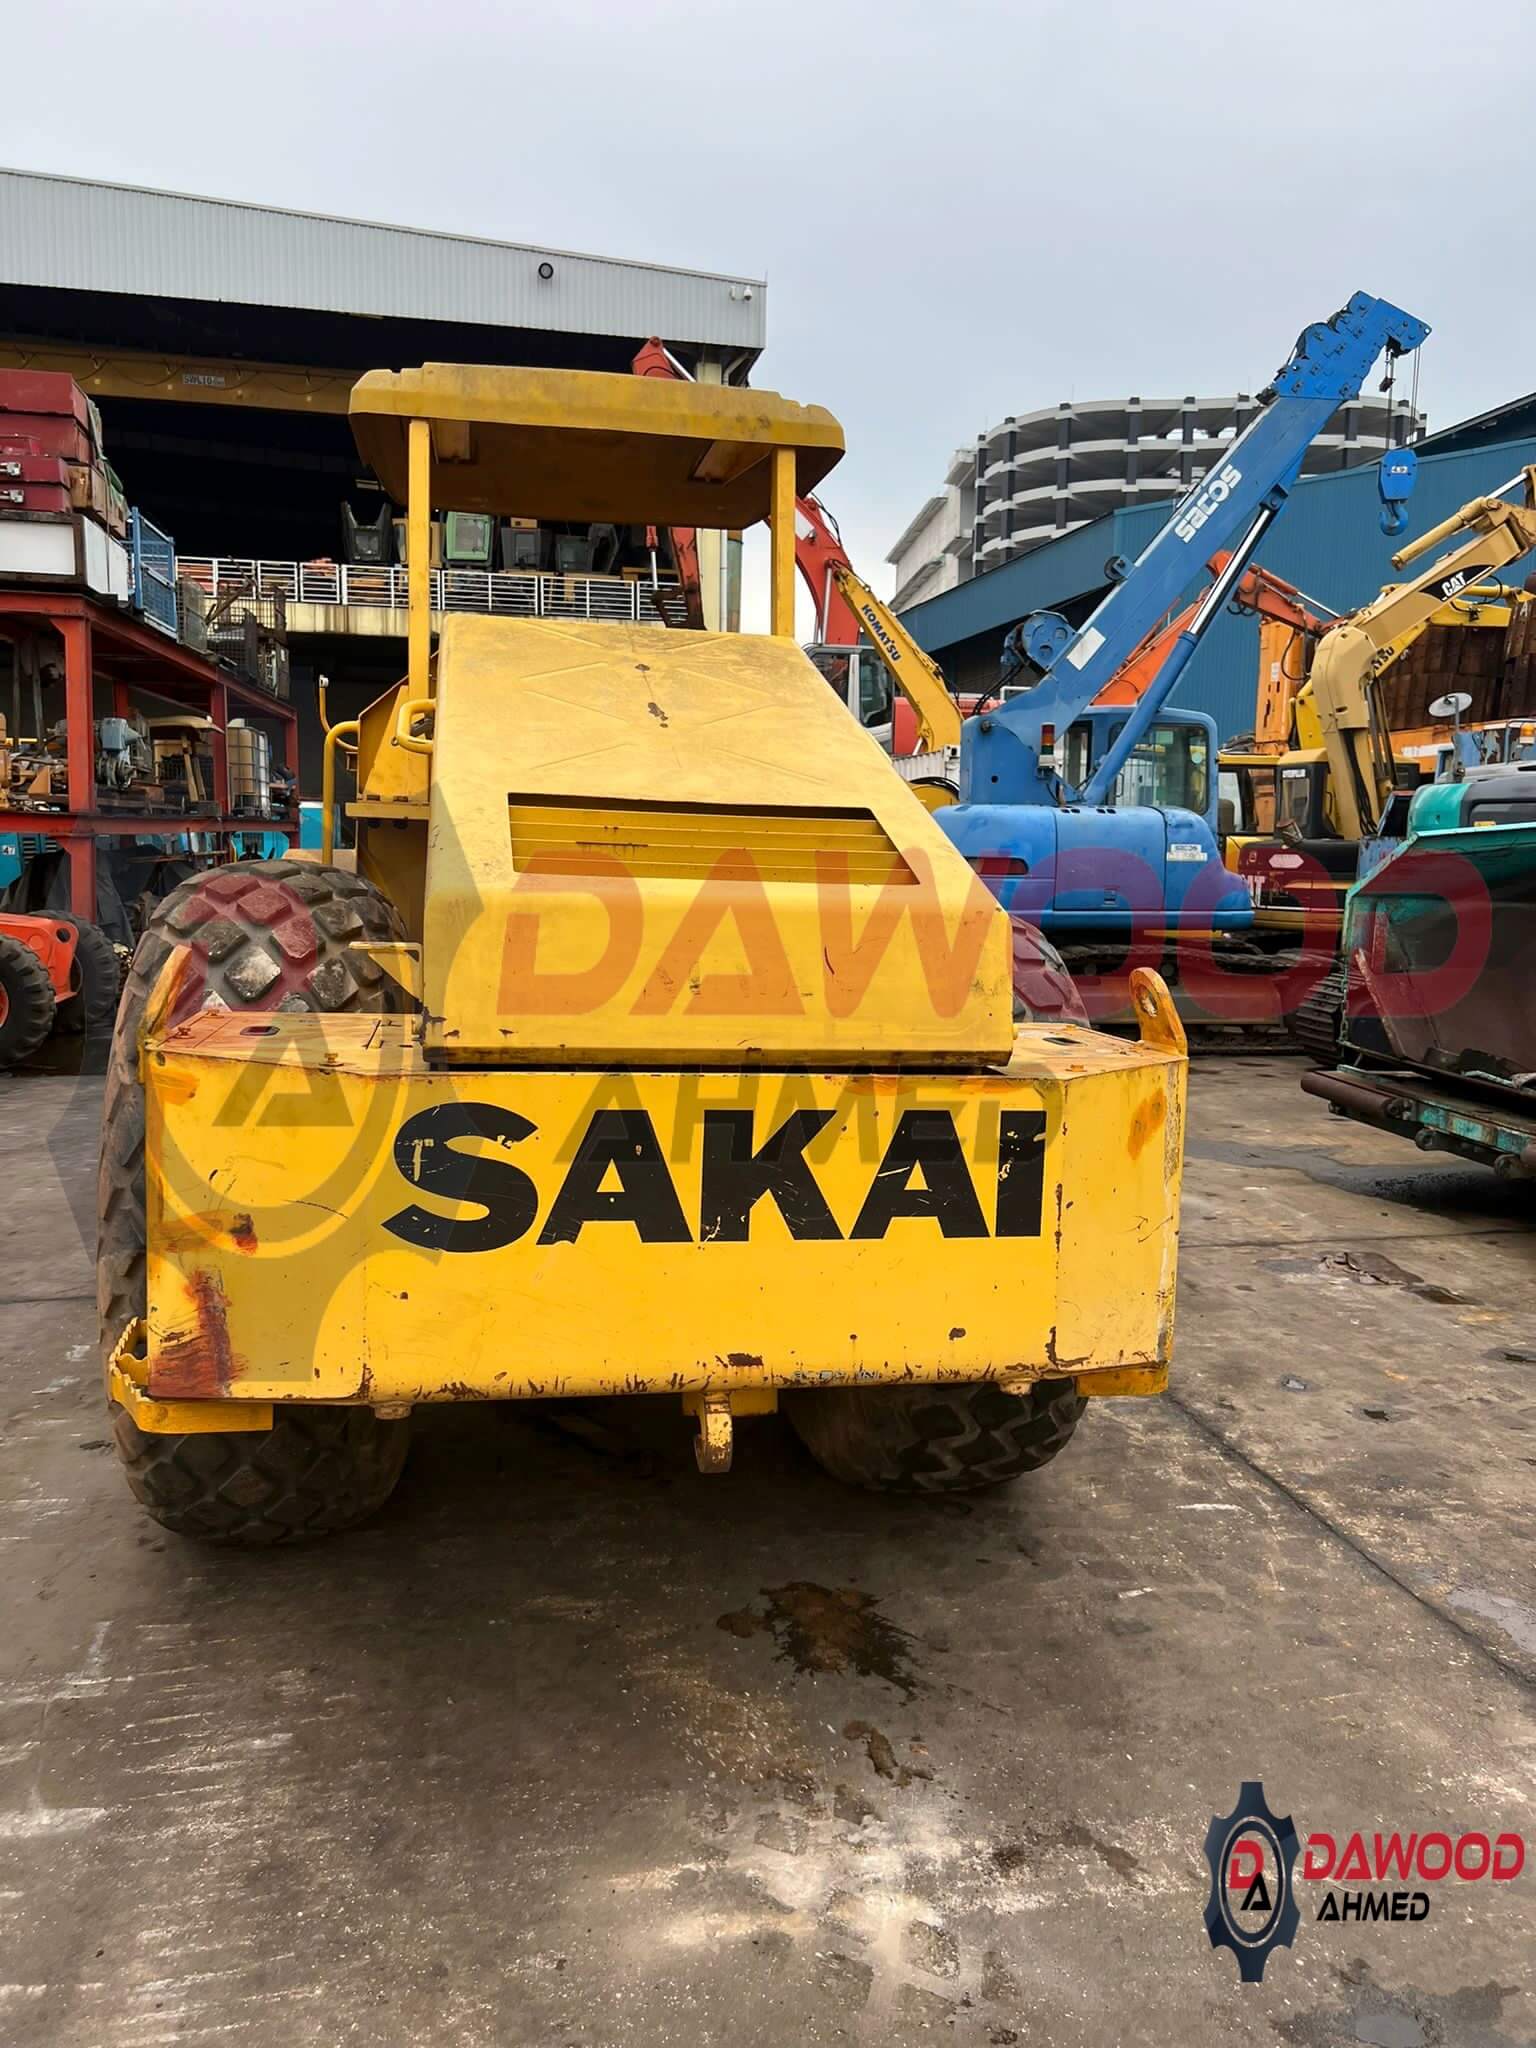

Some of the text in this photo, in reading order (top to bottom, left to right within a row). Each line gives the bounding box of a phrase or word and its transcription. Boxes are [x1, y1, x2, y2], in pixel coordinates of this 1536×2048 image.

[1441, 572, 1466, 597] CAT
[862, 604, 901, 661] KOMATSU
[380, 1102, 1048, 1254] SAKAI
